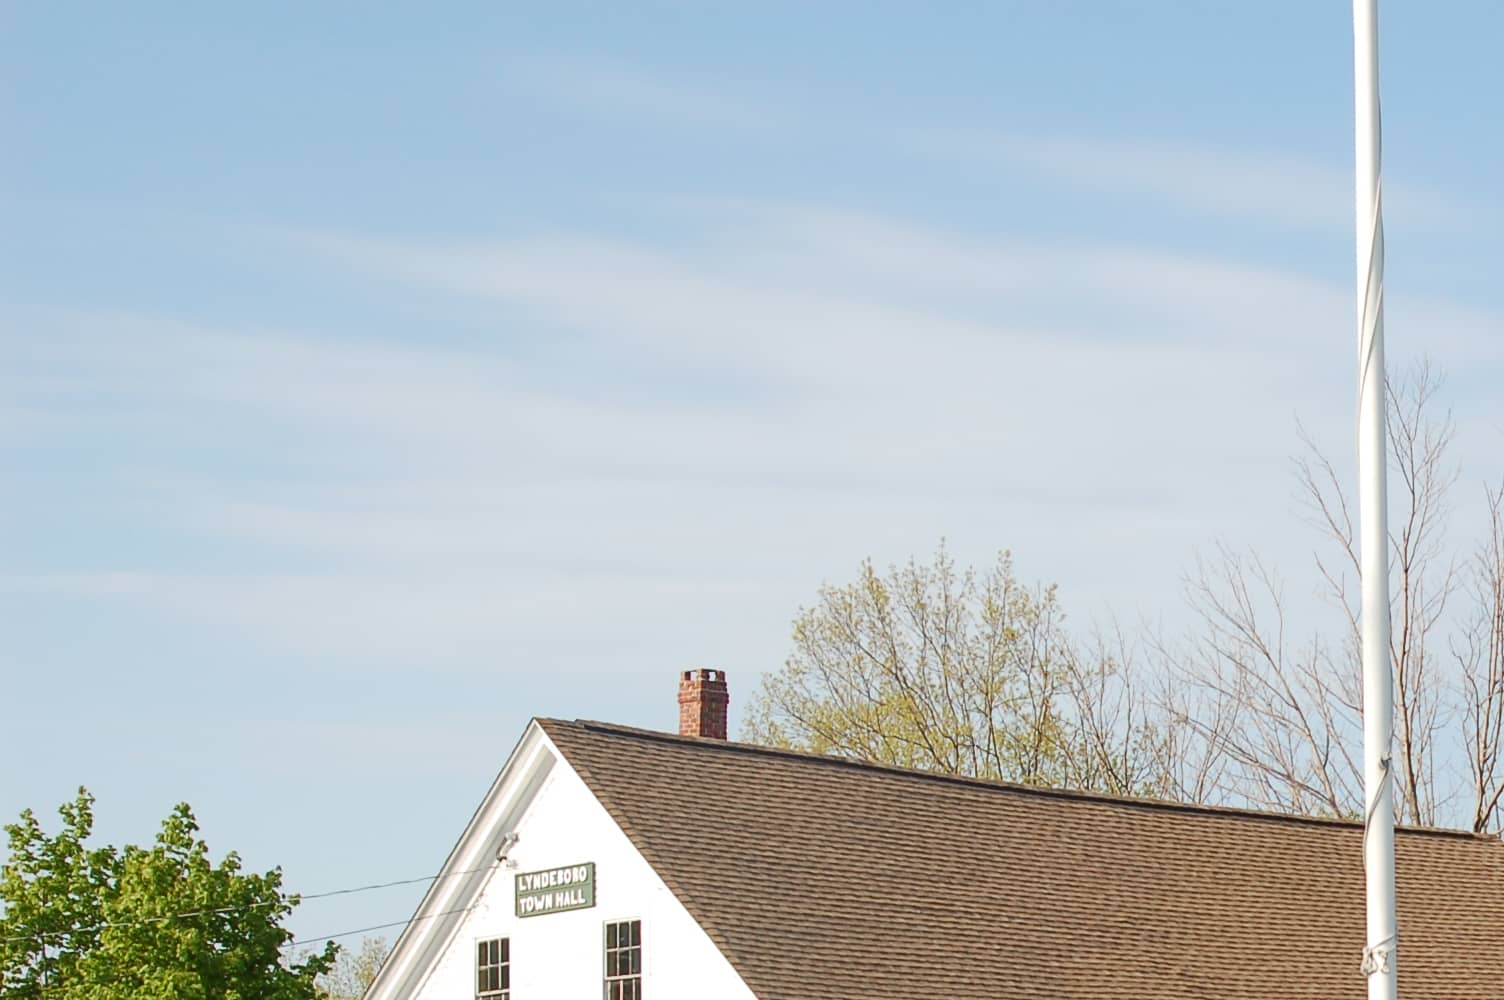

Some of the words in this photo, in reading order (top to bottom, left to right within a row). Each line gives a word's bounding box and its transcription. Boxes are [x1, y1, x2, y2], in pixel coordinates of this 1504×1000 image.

[518, 866, 587, 891] LYNDEBORO
[519, 893, 553, 914] TOWN
[555, 889, 586, 908] HALL
